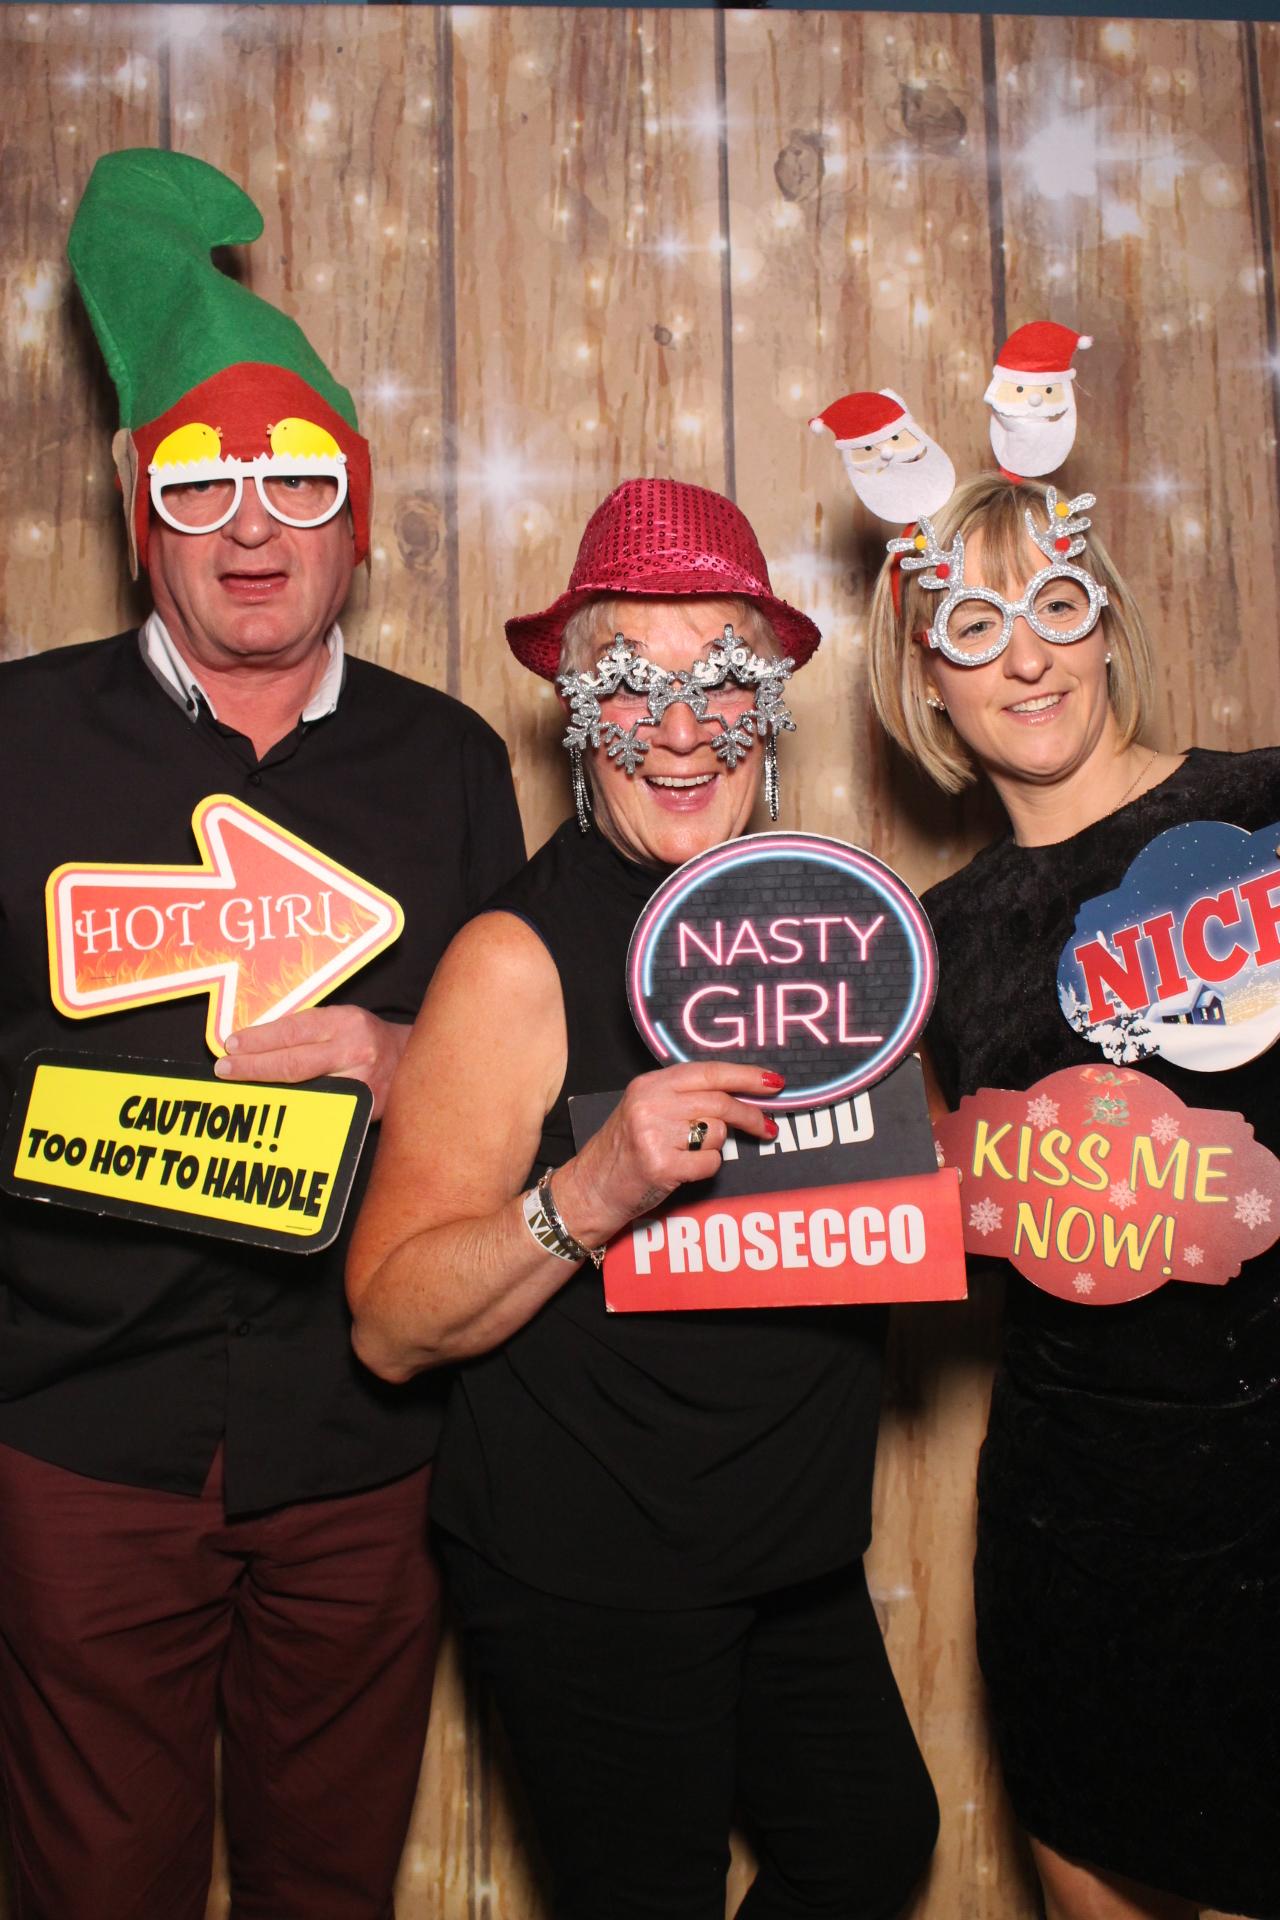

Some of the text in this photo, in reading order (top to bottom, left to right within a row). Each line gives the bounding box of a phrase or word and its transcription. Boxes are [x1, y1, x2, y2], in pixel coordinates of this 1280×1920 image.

[76, 890, 352, 955] HOT GIRL
[678, 914, 886, 968] NASTY
[1074, 868, 1280, 1025] NICE
[682, 980, 884, 1049] GIRL
[118, 1094, 288, 1153] CAUTION!!
[28, 1128, 329, 1218] TOO HOT TO HANDLE
[972, 1119, 1234, 1203] KISS ME
[632, 1203, 927, 1275] PROSECCO
[1013, 1196, 1177, 1276] NOW!
